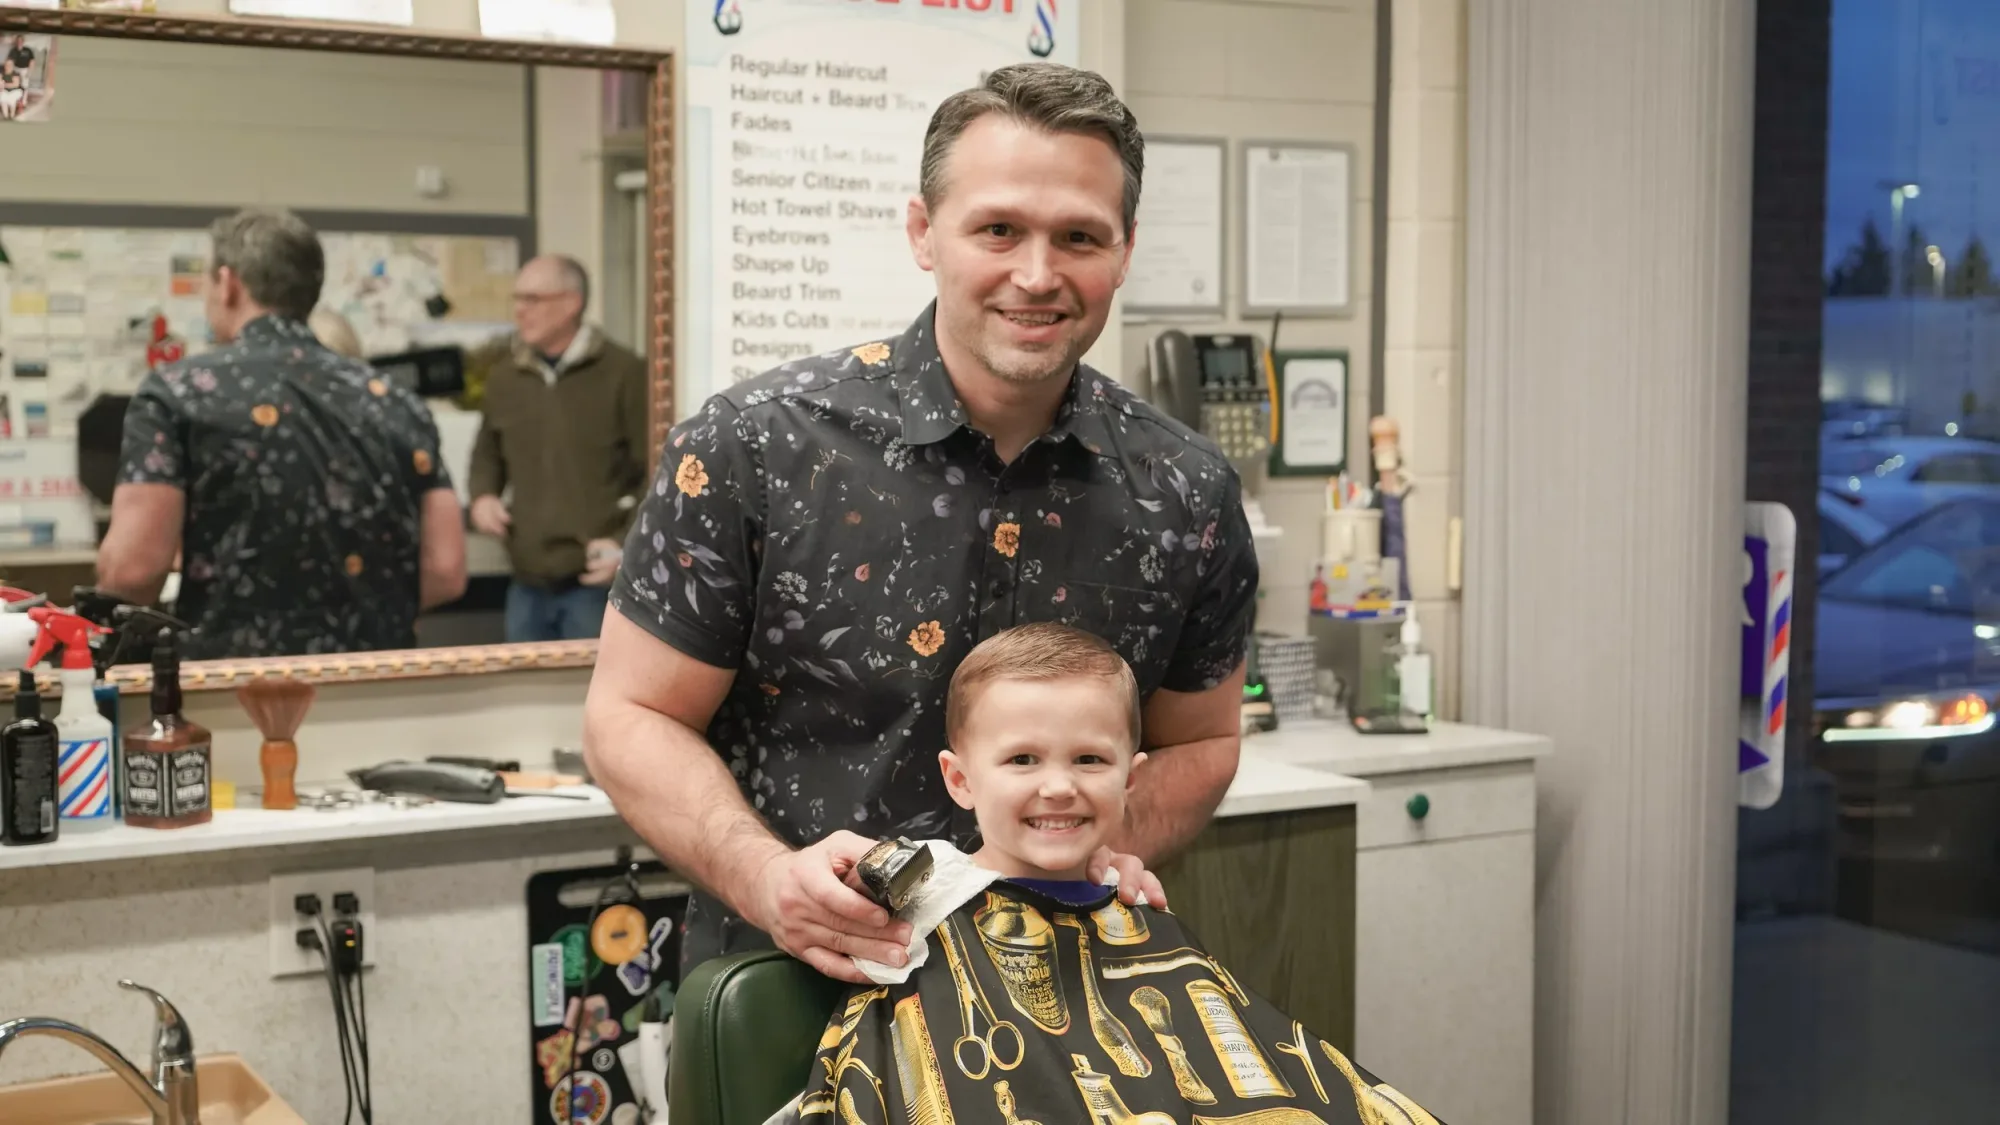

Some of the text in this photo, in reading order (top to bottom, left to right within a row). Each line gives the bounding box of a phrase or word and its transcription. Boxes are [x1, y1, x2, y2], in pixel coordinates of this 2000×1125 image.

[730, 54, 888, 82] Regular Haircut
[730, 84, 803, 105] Haircut
[829, 89, 887, 110] Beard
[731, 112, 792, 132] Fades
[732, 168, 795, 189] Senior
[803, 172, 871, 192] Citizen
[732, 198, 897, 220] Hot Towel Shave
[732, 226, 831, 247] Eyebrows
[732, 254, 829, 275] Shape Up
[732, 281, 841, 301] Beard Trim
[732, 310, 776, 329] Kids
[783, 311, 829, 329] Cuts
[732, 337, 813, 359] Designs
